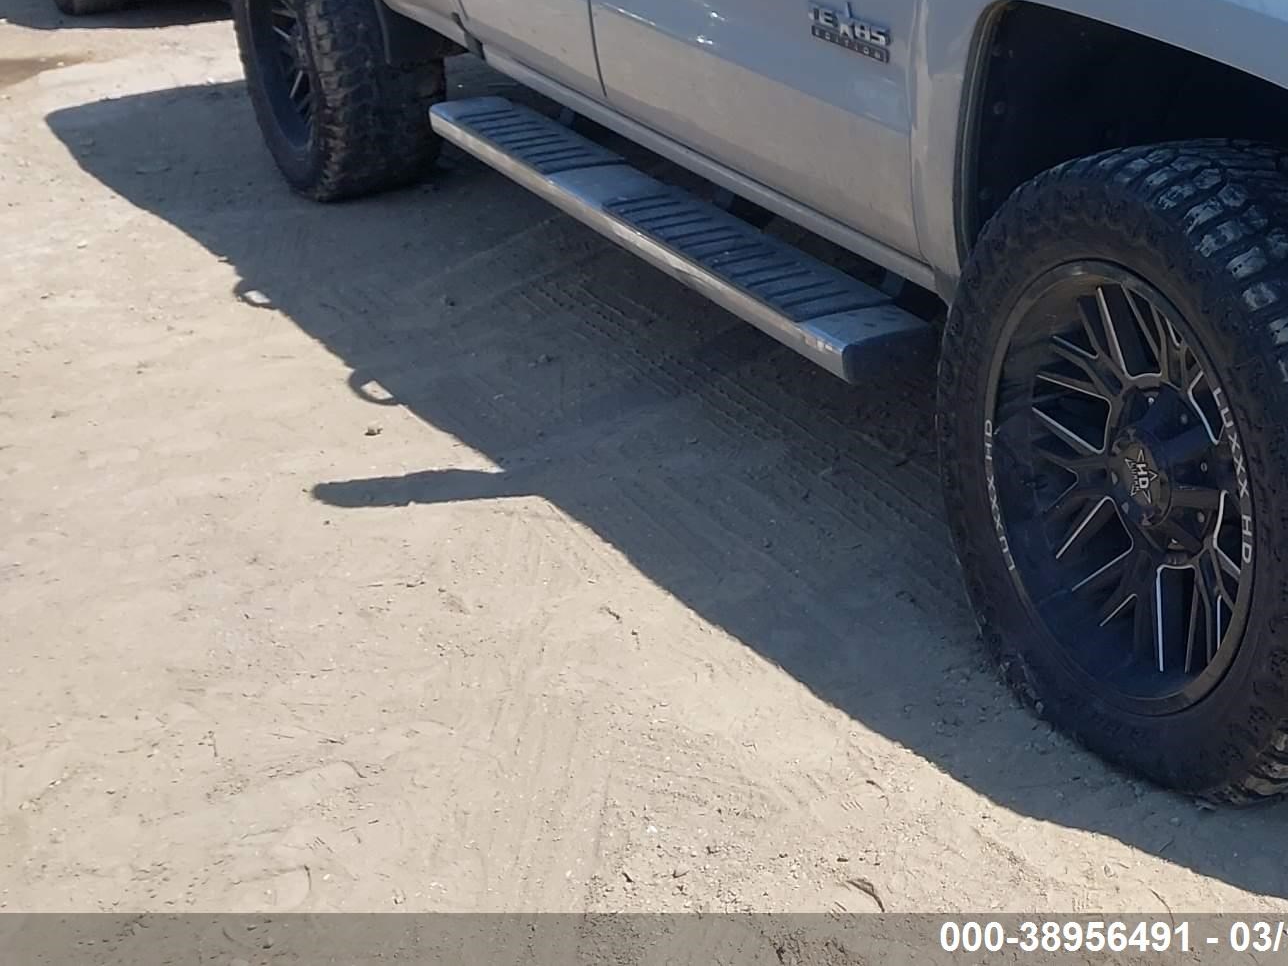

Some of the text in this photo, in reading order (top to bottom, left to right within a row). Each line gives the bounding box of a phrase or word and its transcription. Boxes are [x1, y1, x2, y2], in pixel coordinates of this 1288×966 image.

[1136, 463, 1150, 489] HD
[1212, 386, 1253, 564] LUXXX HD
